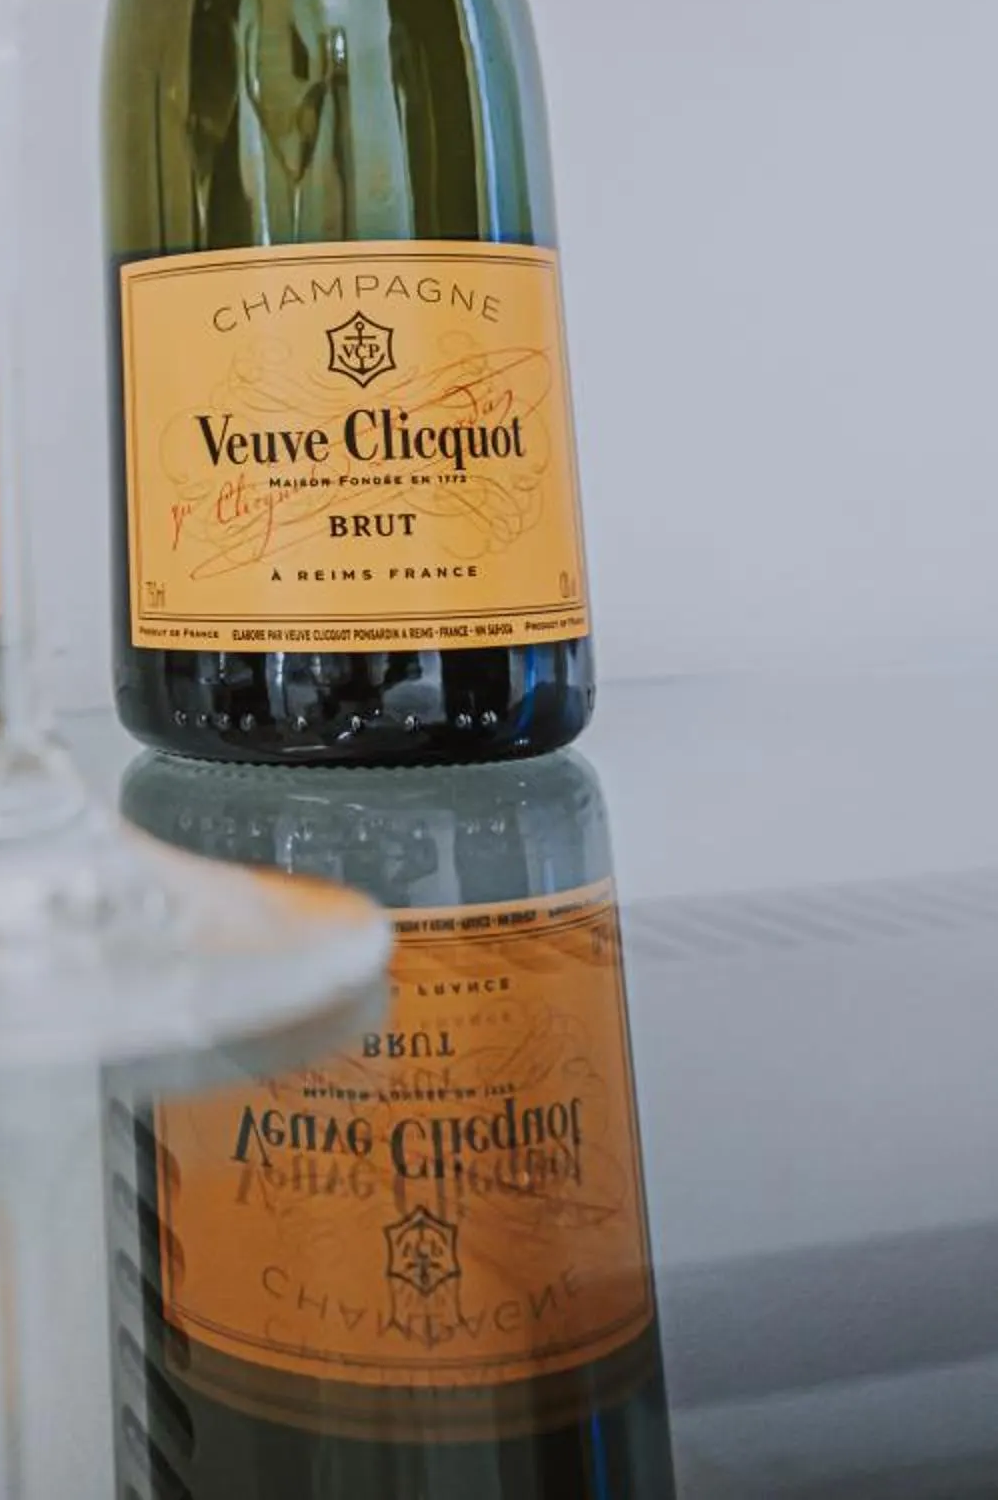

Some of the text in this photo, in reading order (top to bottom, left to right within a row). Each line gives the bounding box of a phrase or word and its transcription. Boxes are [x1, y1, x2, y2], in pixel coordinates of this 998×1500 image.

[213, 274, 503, 333] CHAMPAGNE
[197, 408, 526, 470] Veuve Clicquot
[329, 514, 417, 537] BRUT
[297, 569, 373, 581] REIMS
[389, 566, 478, 580] FRANCE
